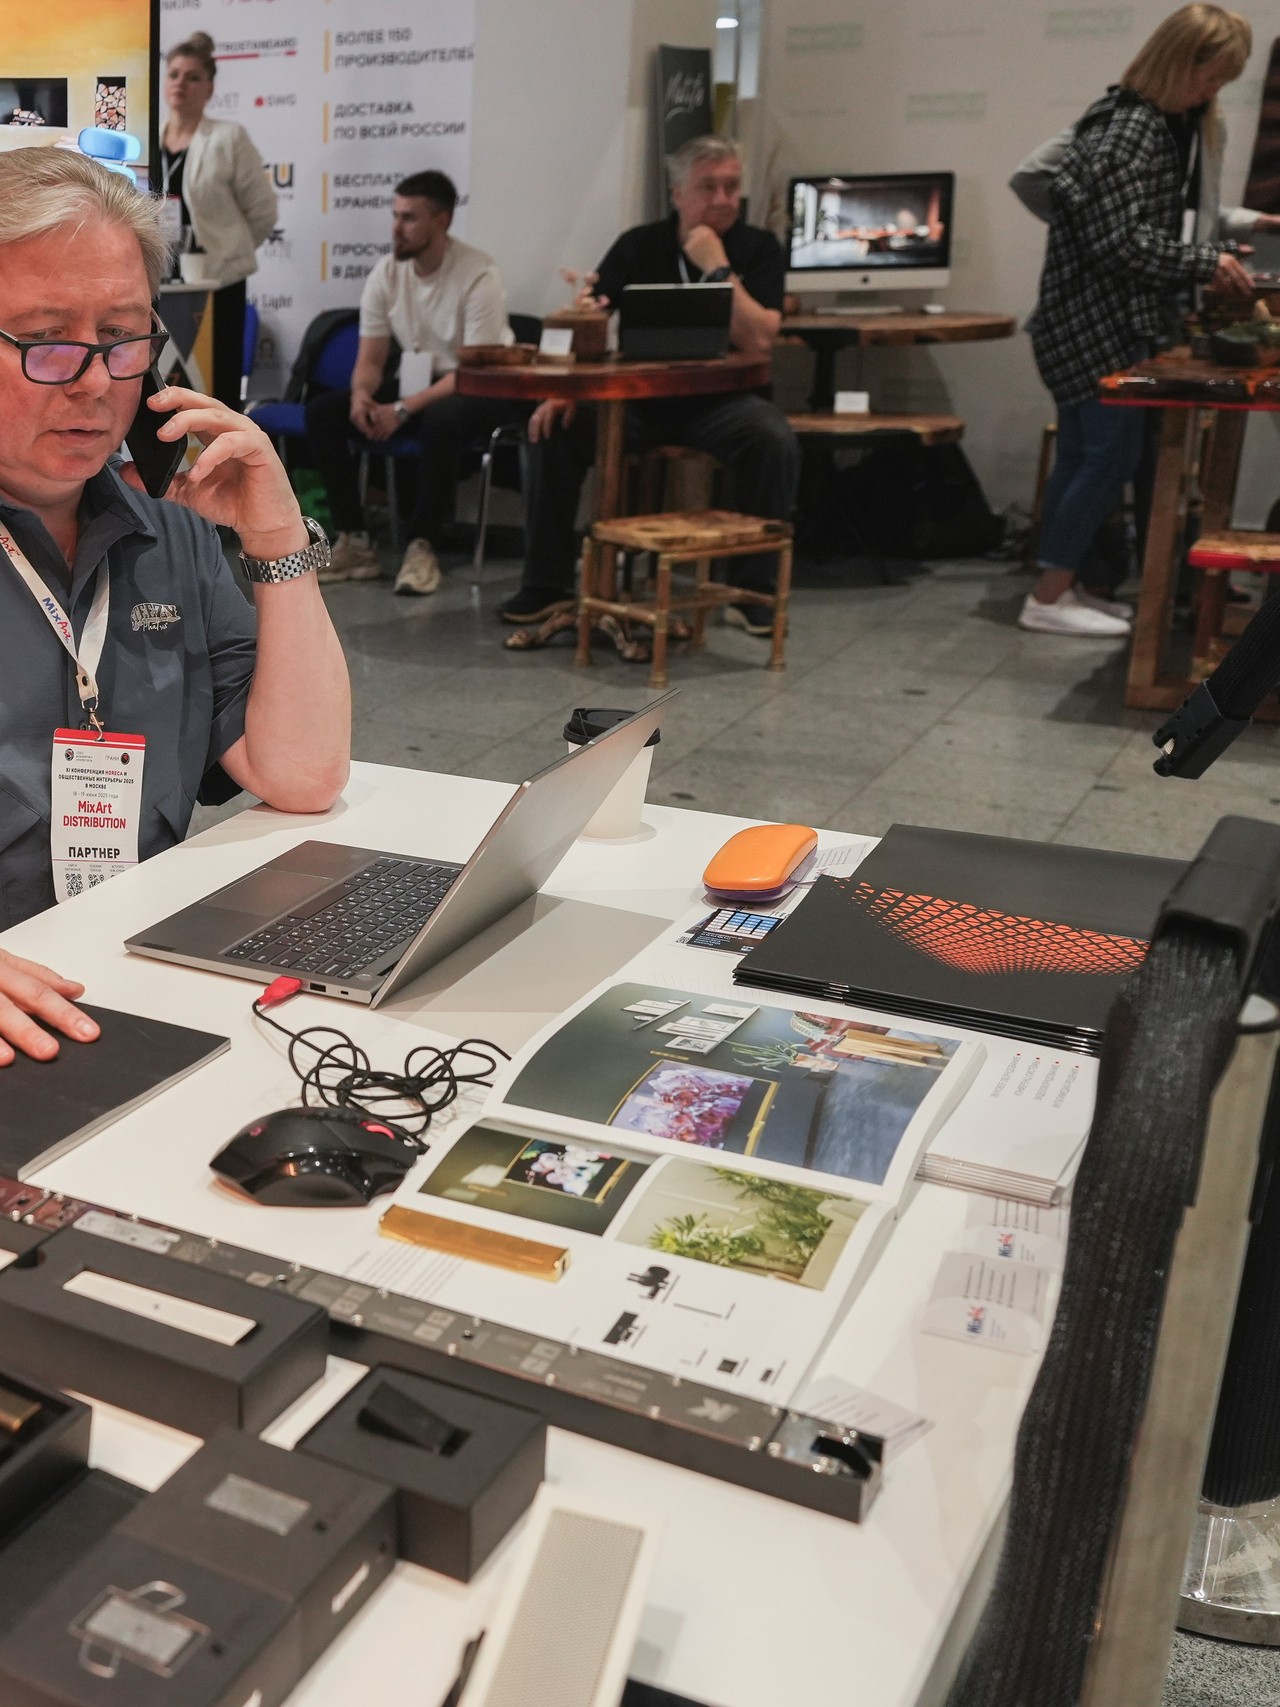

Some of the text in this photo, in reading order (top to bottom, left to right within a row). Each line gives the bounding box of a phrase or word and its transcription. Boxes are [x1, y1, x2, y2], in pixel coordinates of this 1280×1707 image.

[335, 29, 385, 46] БОЛЕЕ
[334, 101, 415, 119] ДОСТАВКА
[334, 119, 466, 141] ПО ВСЕЙ РОССИИ
[333, 172, 406, 188] БЕСПЛАТ
[334, 195, 394, 210] ХРАНЕН
[332, 242, 394, 257] ПРОСЧЕ
[42, 597, 72, 640] MixArt
[58, 774, 96, 782] ОБЩЕСТВЕННЫЕ
[77, 800, 113, 814] MixArt
[63, 815, 127, 829] DISTRIBUTION
[68, 846, 121, 859] ПАРТНЕР
